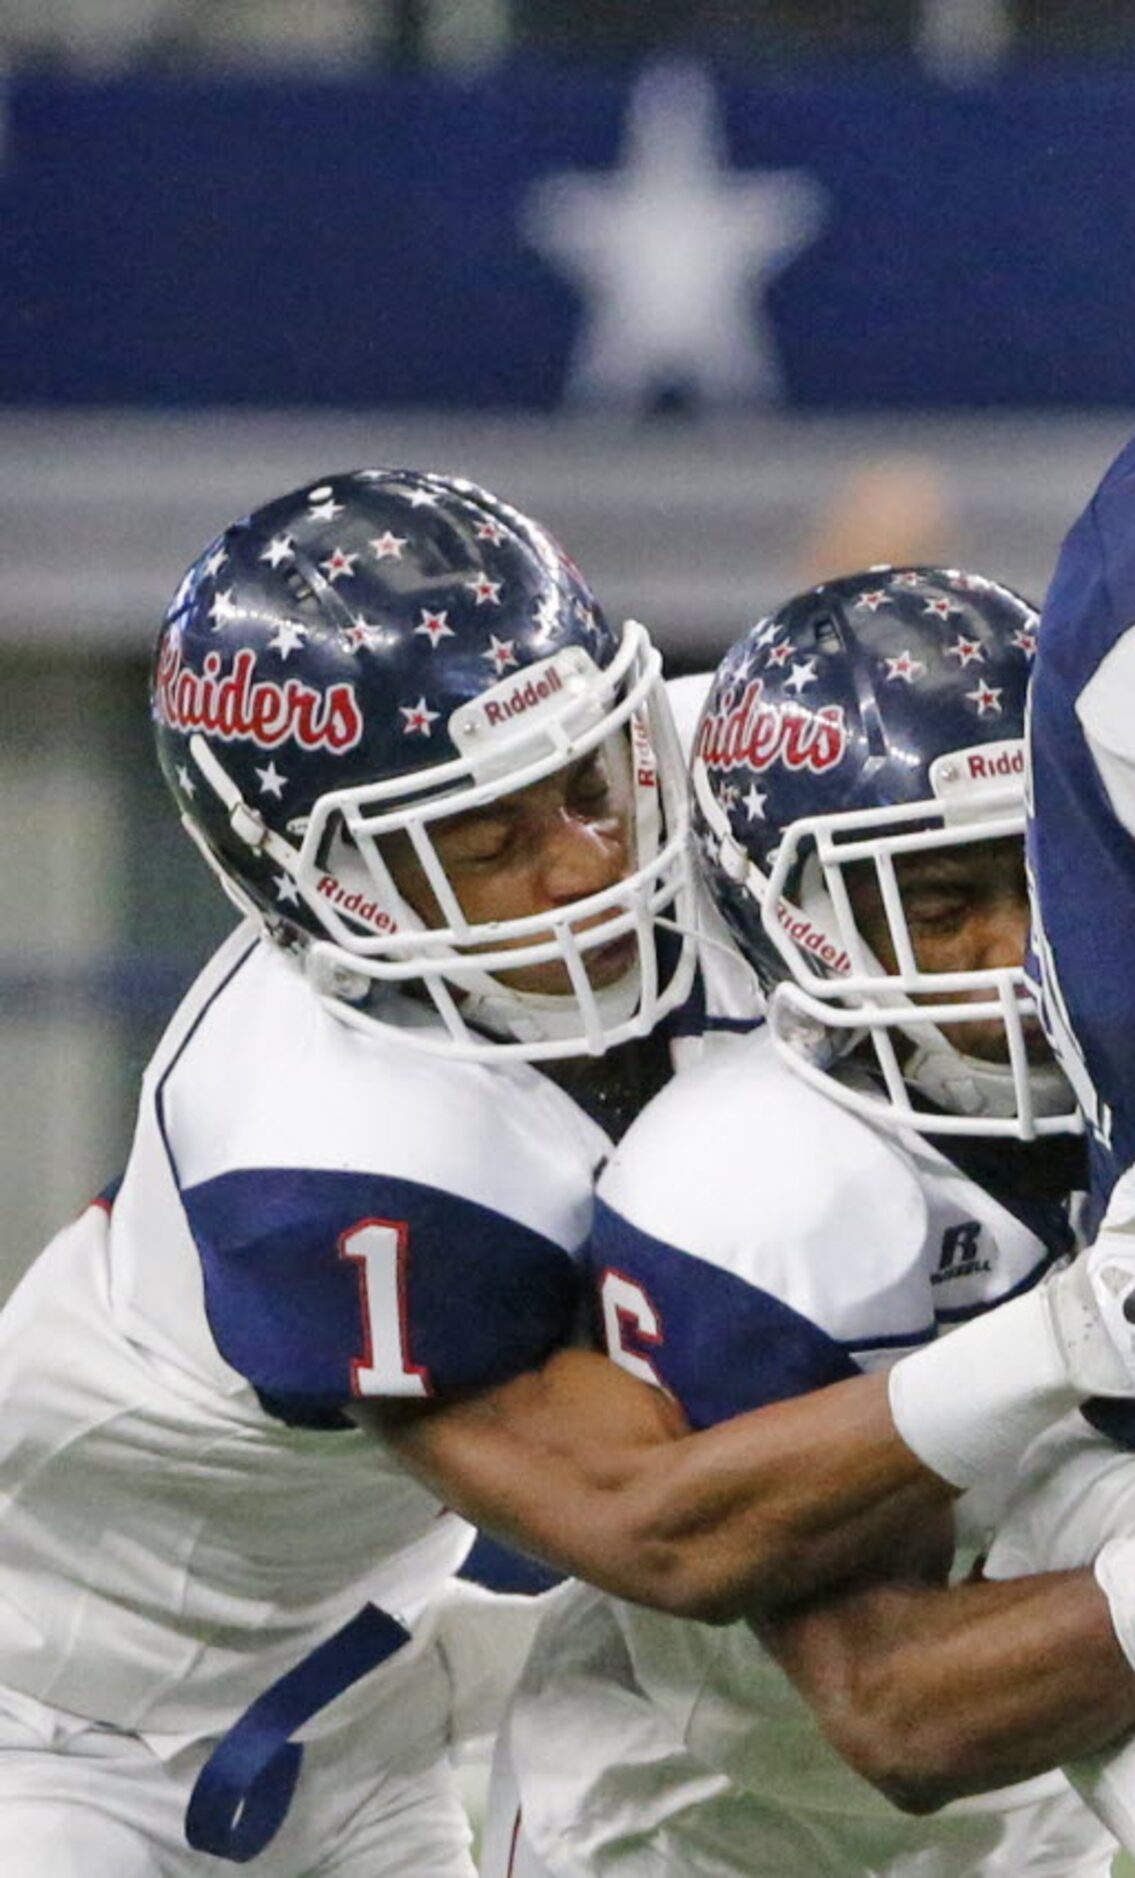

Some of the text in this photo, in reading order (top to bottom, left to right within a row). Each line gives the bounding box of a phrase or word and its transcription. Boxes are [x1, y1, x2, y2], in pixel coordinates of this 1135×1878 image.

[158, 640, 363, 755] Raiders
[484, 666, 562, 726] Riddell
[338, 1217, 436, 1398] 1
